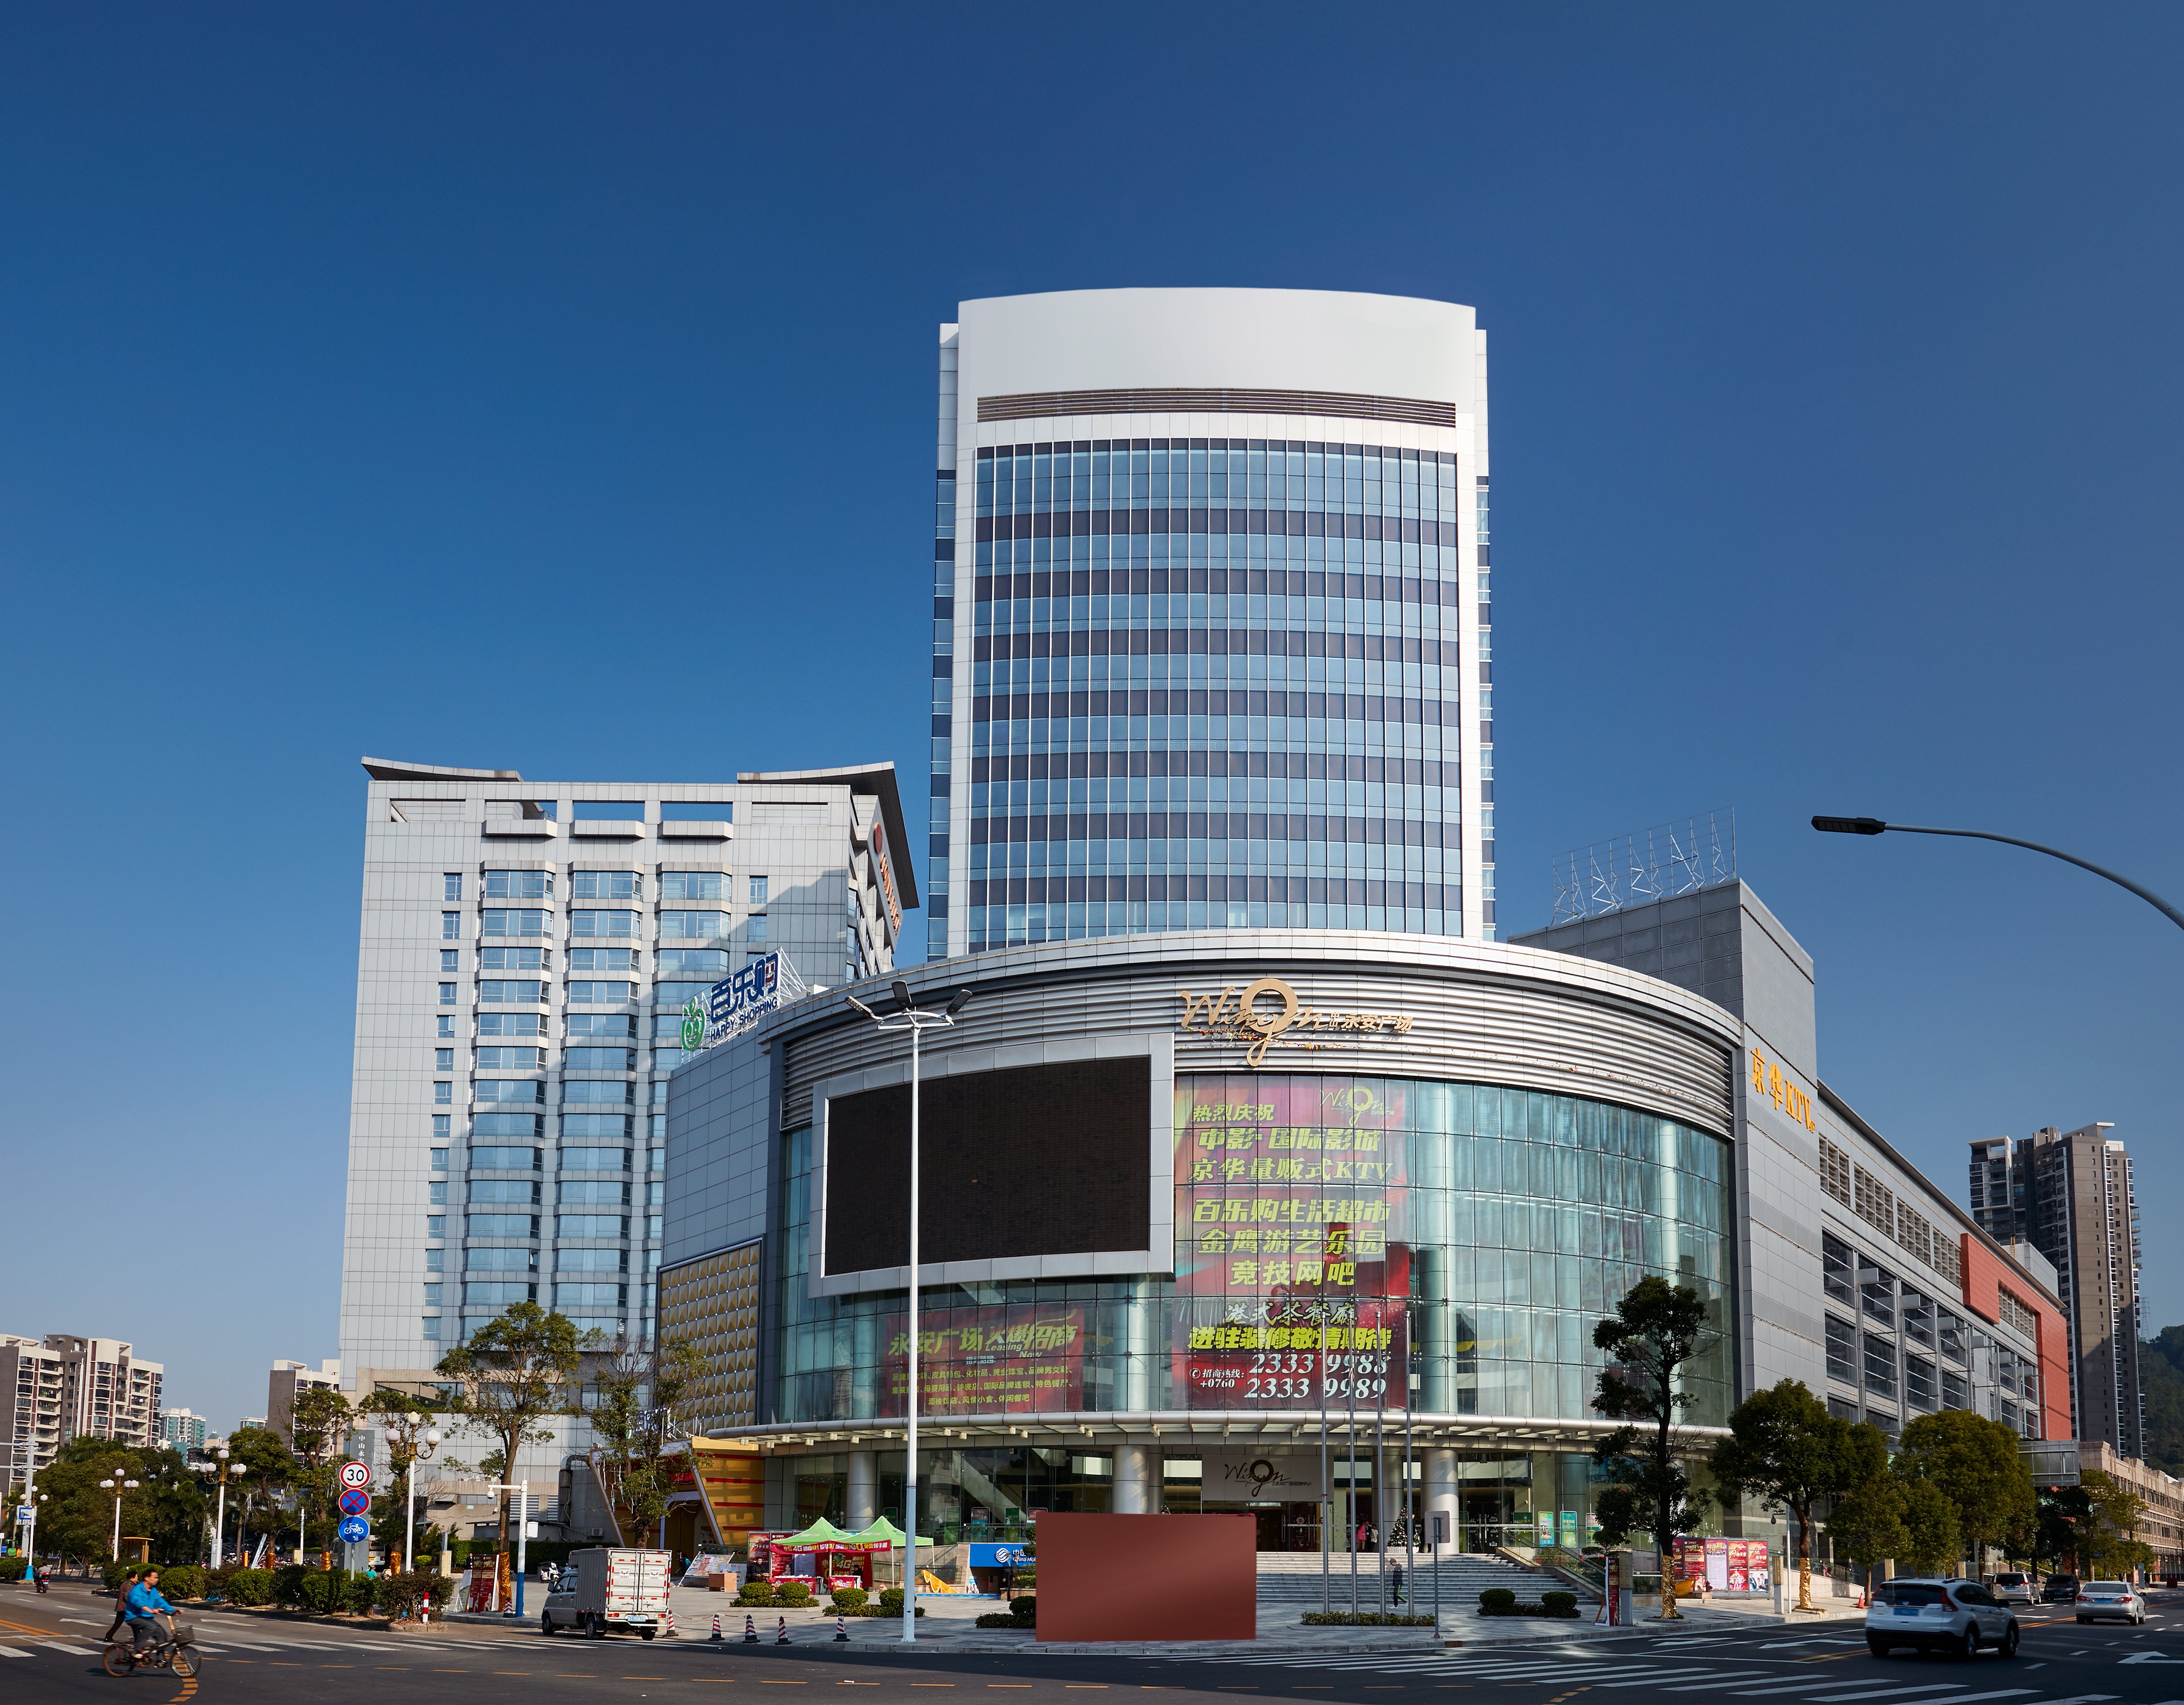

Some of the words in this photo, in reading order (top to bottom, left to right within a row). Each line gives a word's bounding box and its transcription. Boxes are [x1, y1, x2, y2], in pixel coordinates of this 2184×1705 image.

[711, 952, 779, 1023] 百乐购
[711, 1018, 735, 1041] HAPPY
[740, 996, 778, 1026] SHOPPING
[1191, 1104, 1275, 1122] 热烈庆祝
[1193, 1198, 1392, 1223] 百乐购生活超市
[1198, 1228, 1386, 1254] 金鹰游艺乐园
[1229, 1260, 1357, 1286] 竞技网吧
[888, 1327, 983, 1356] 永安广场
[985, 1323, 1078, 1351] 火爆招商
[985, 1343, 1022, 1352] Leasing
[1187, 1327, 1392, 1350] 进驻装修敬请期待
[1249, 1354, 1314, 1374] 2333
[1326, 1354, 1388, 1375] 9988
[1200, 1379, 1235, 1388] +0760
[1244, 1378, 1310, 1399] 2333
[1324, 1378, 1387, 1399] 9989
[347, 1469, 364, 1482] 30
